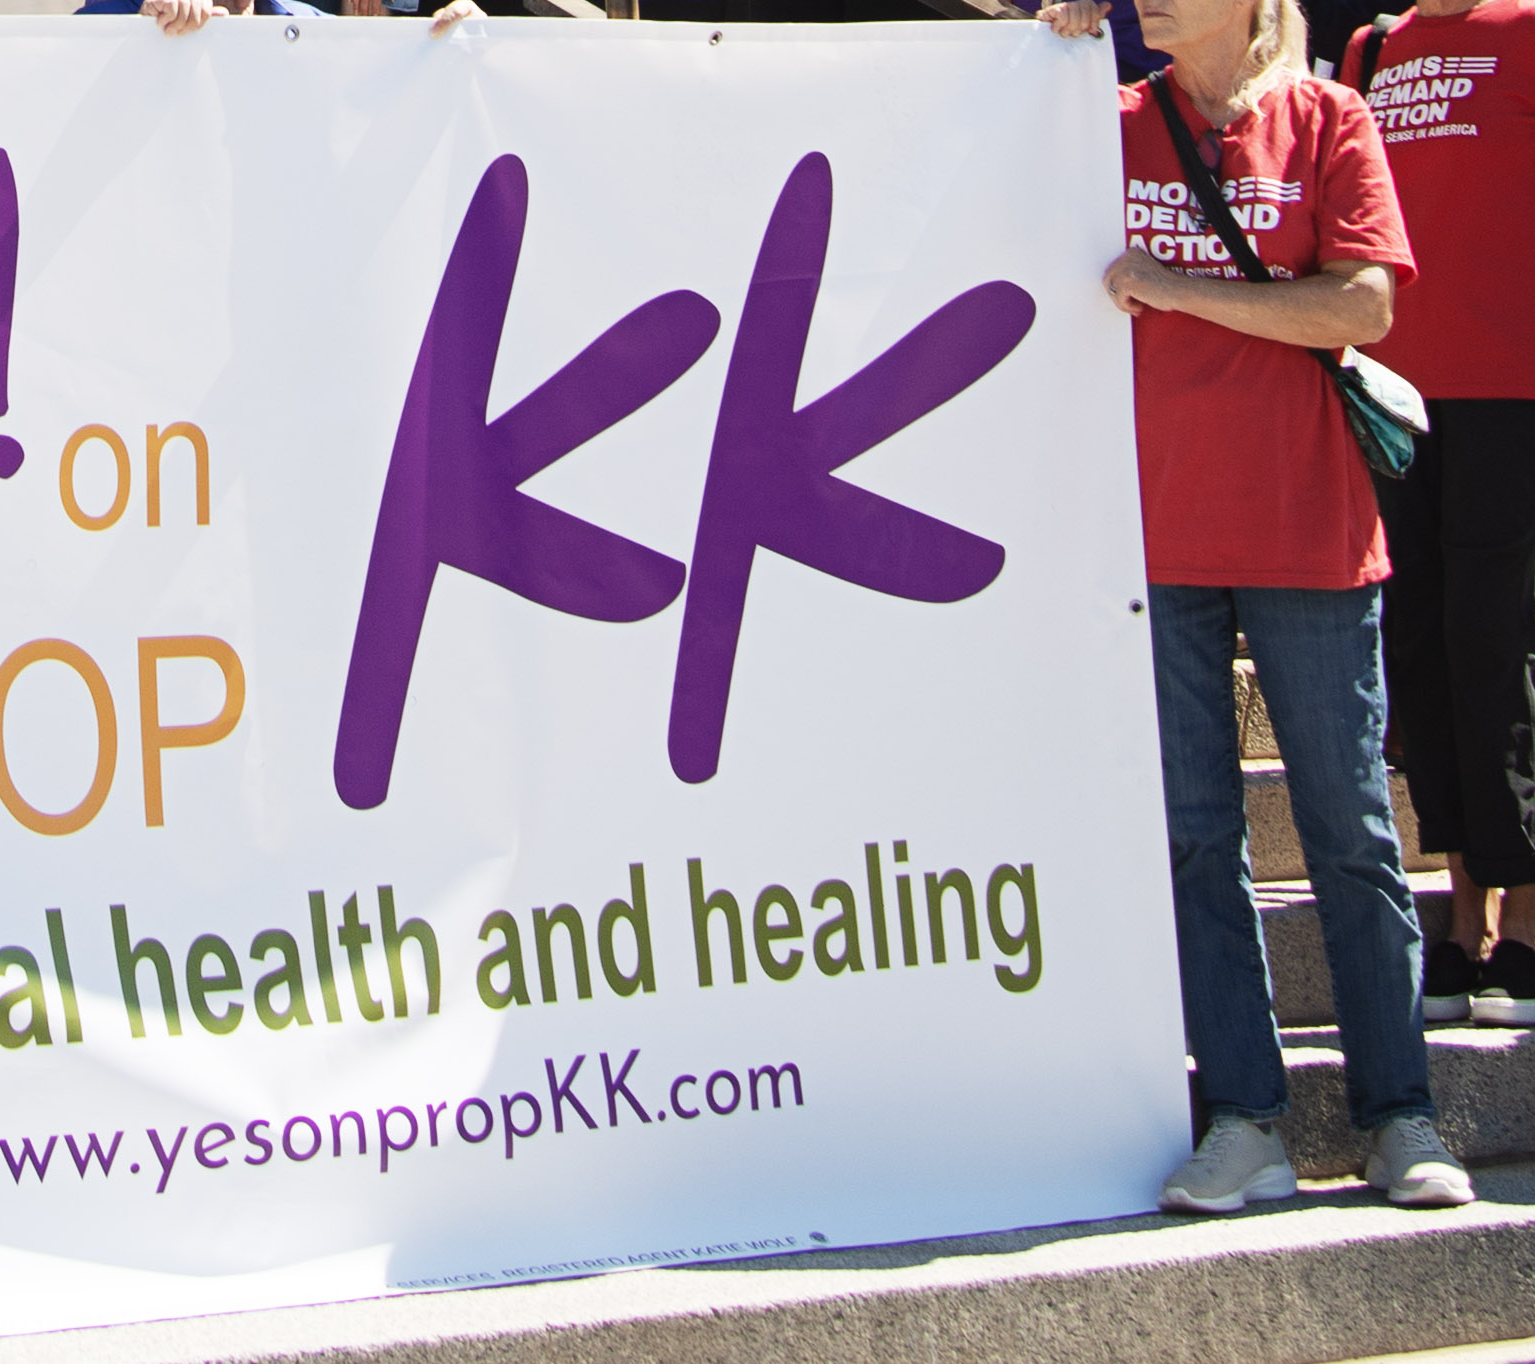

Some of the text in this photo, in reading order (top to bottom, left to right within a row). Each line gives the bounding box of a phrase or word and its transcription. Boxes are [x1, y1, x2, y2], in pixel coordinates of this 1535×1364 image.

[1370, 56, 1443, 90] MOMS
[1366, 78, 1473, 107] DEMAND
[1373, 101, 1449, 128] CTION
[1385, 129, 1415, 143] SENSE
[1416, 128, 1427, 139] IN
[1428, 124, 1477, 137] AMERICA
[1126, 203, 1280, 233] DEMND
[1129, 234, 1259, 262] ACTIO
[58, 421, 211, 533] on
[333, 150, 1034, 810] KK
[109, 884, 442, 1039] health
[478, 862, 657, 1012] and
[688, 839, 1044, 996] healing
[690, 1241, 742, 1258] KATIE
[745, 1235, 799, 1251] WOLF
